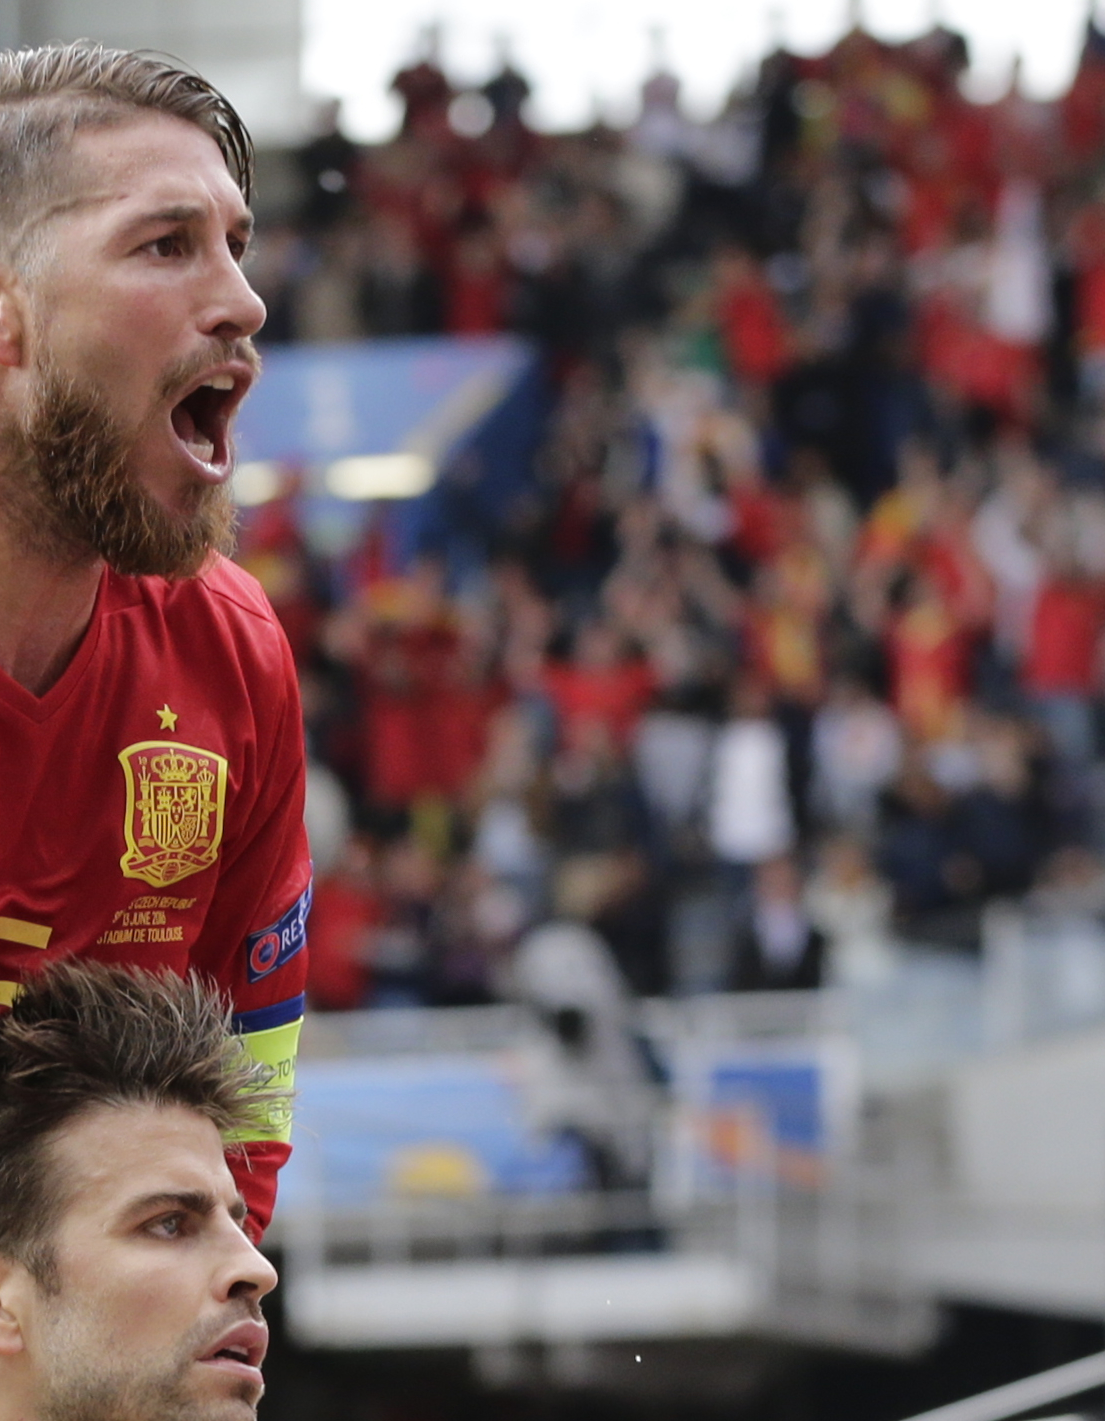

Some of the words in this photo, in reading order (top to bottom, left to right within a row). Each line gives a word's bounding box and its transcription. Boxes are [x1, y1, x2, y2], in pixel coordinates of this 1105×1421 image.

[130, 910, 151, 925] JUNE
[134, 928, 146, 943] DE
[147, 926, 184, 943] TOULOUSE
[277, 1059, 292, 1079] TO
